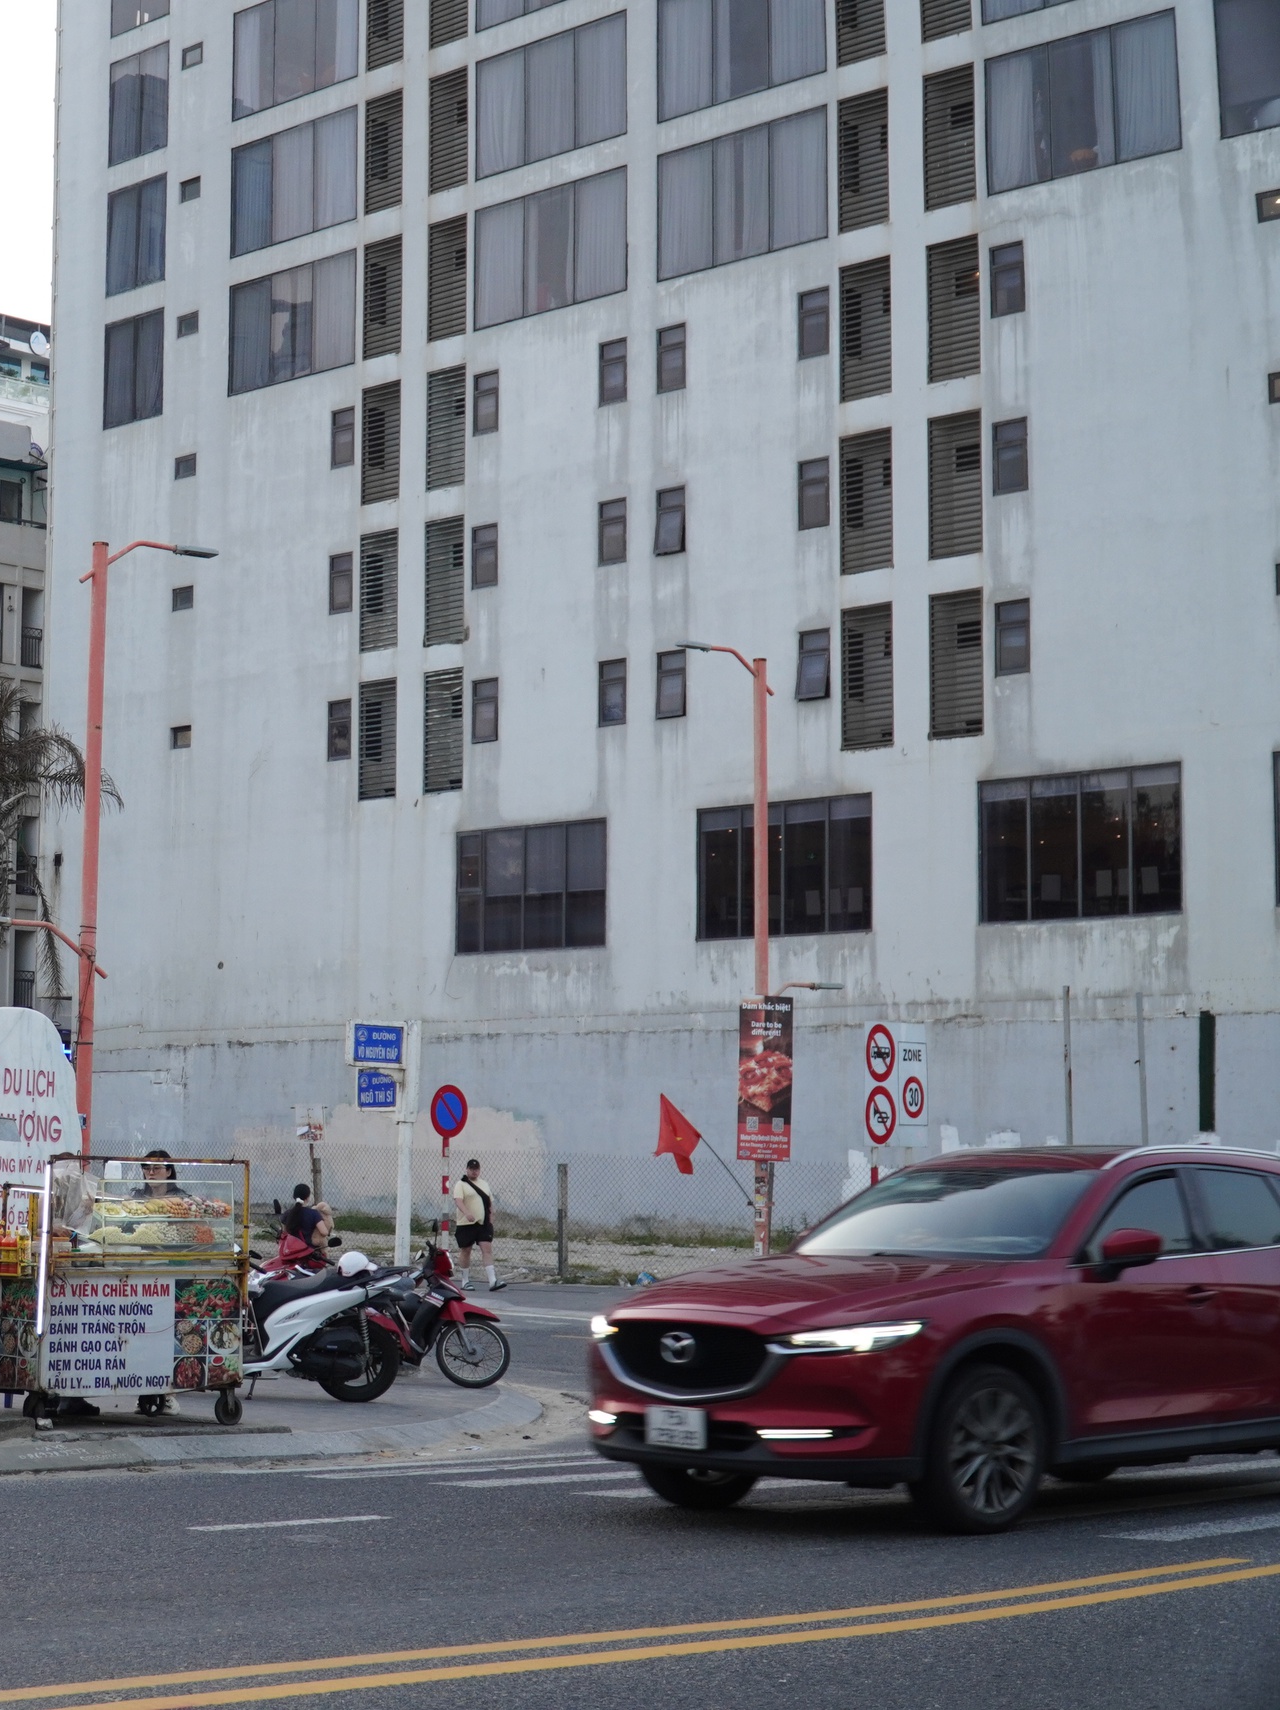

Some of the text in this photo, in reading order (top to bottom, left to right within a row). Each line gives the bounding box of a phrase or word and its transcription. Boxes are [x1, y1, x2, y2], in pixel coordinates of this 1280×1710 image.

[372, 1030, 396, 1040] ĐƯỜNG
[386, 1045, 398, 1060] GIÁP
[903, 1049, 922, 1062] ZONE
[3, 1067, 23, 1096] DU
[25, 1069, 55, 1103] LỊCH
[360, 1088, 394, 1103] NGÔ THÌ SĨ
[908, 1087, 919, 1107] 30
[19, 1156, 33, 1173] MỸ
[71, 1280, 99, 1297] VIÊN
[102, 1280, 138, 1297] CHIÊN
[142, 1278, 170, 1297] MẮM
[50, 1301, 153, 1316] BÁNH TRÁNG NƯỚNG
[49, 1319, 146, 1336] BÁNH TRÁNG TRỘN
[49, 1338, 77, 1353] BÁNH
[81, 1340, 101, 1355] GẠO
[48, 1355, 126, 1371] NEM CHUA RÁN
[48, 1372, 67, 1390] LẨU
[116, 1373, 143, 1388] NƯỚC
[145, 1375, 170, 1389] NGỌT
